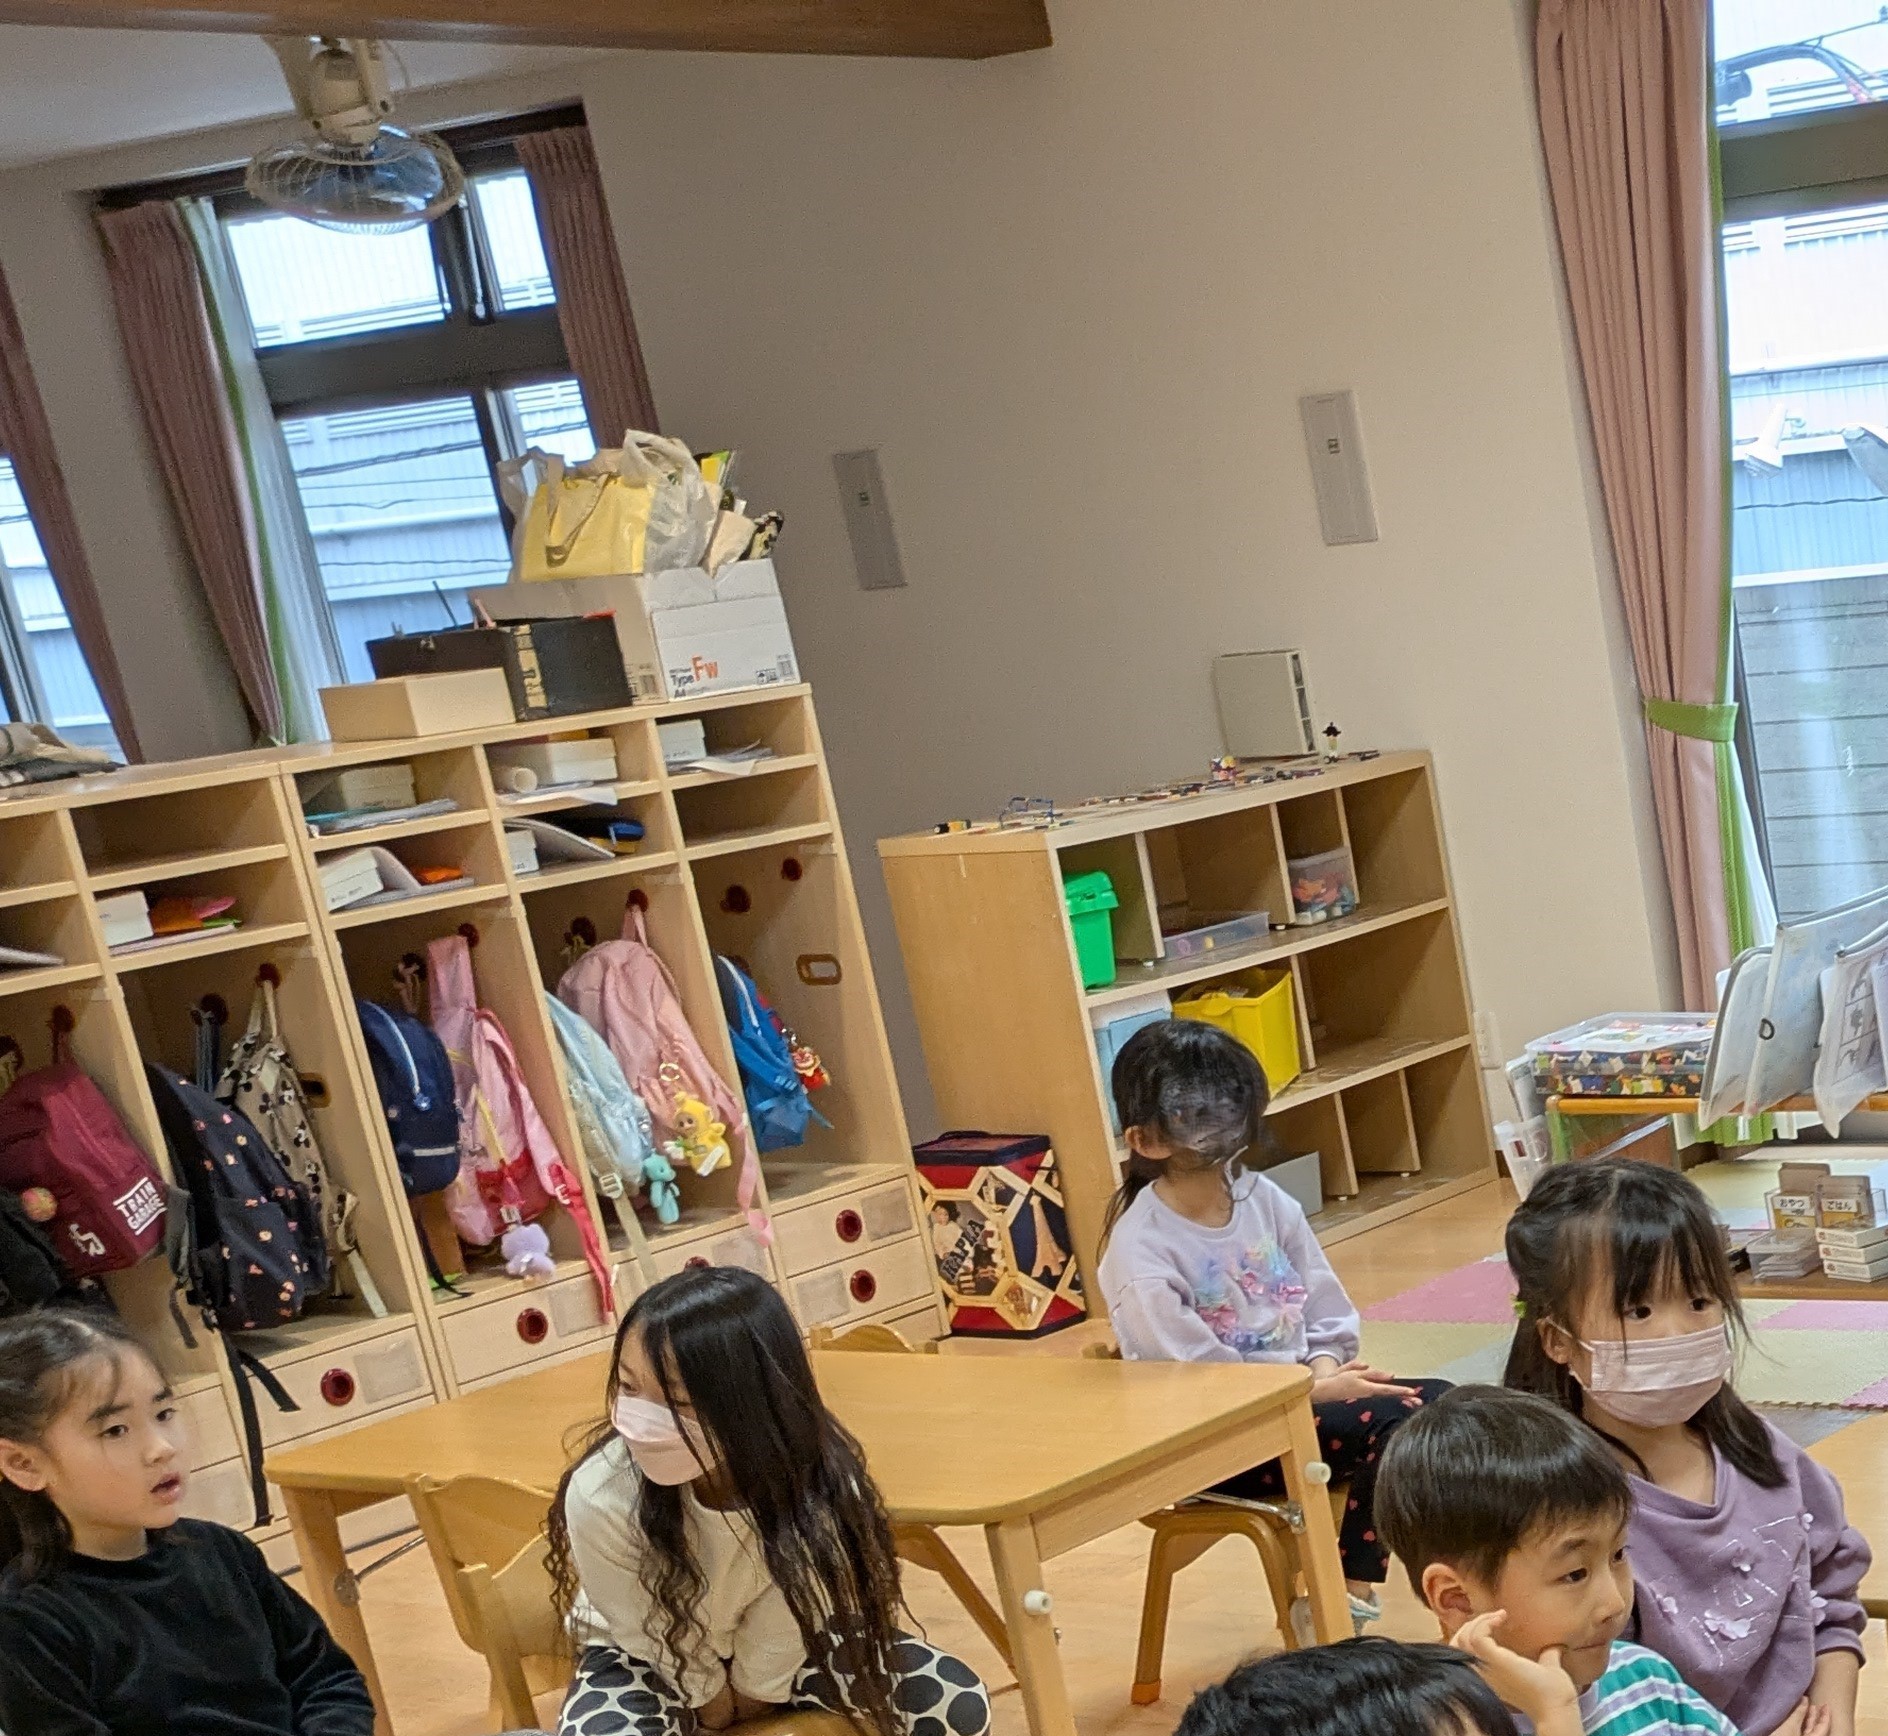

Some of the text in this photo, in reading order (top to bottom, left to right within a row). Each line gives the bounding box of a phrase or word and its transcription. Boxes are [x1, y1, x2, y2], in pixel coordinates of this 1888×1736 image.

[671, 675, 694, 687] Type
[117, 1181, 156, 1217] TRAIN
[1779, 1198, 1805, 1208] おやつ
[1827, 1200, 1852, 1211] ごはん
[127, 1194, 164, 1230] GARAGE
